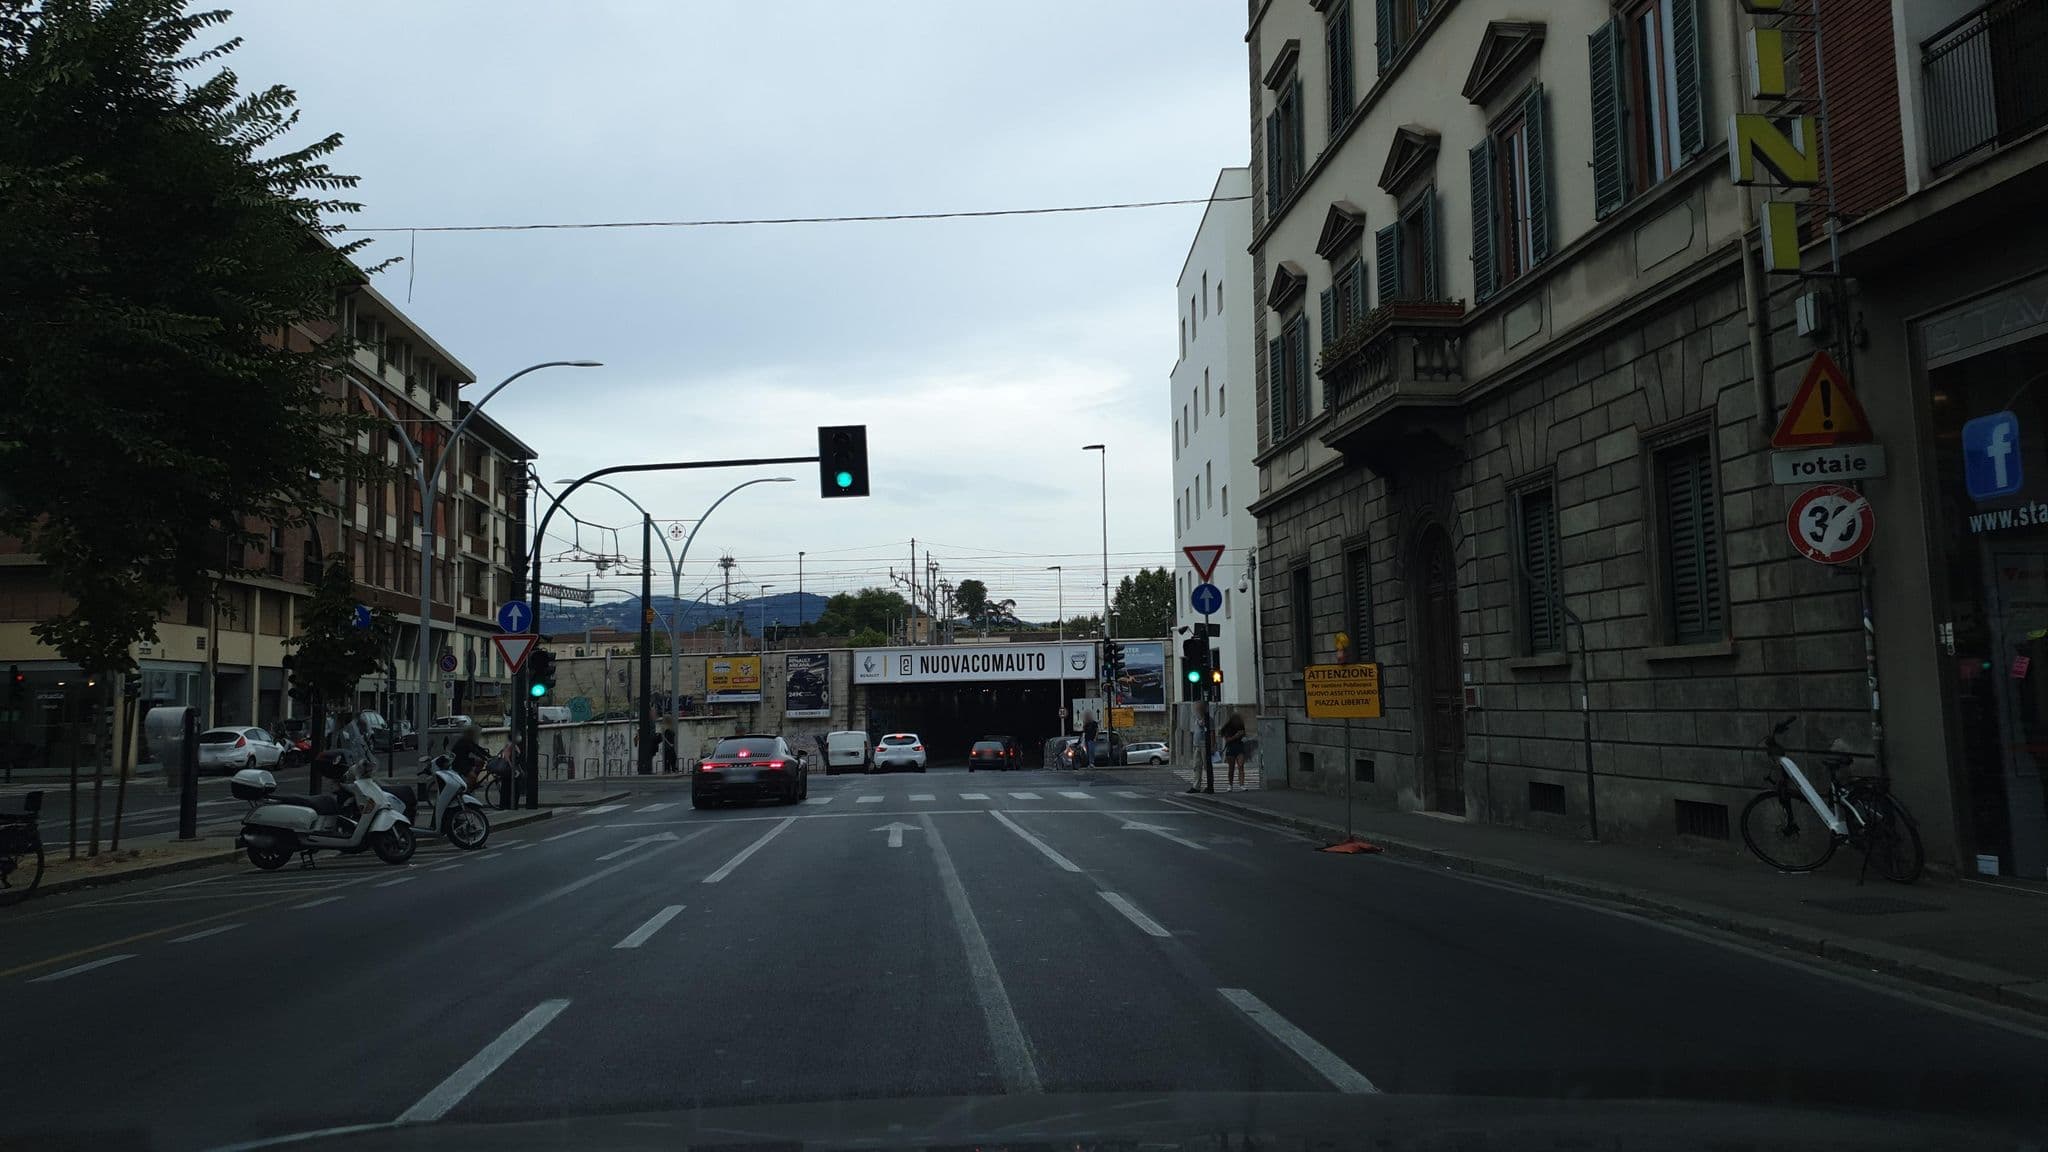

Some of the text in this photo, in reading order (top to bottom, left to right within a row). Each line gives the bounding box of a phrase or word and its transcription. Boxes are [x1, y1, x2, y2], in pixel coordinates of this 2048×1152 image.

[1728, 0, 1819, 273] INI
[1791, 454, 1867, 476] rotaie
[1968, 499, 2048, 533] www.sta
[920, 652, 1045, 674] NUOVACOMAUTO
[1308, 668, 1374, 680] ATTENZIONE
